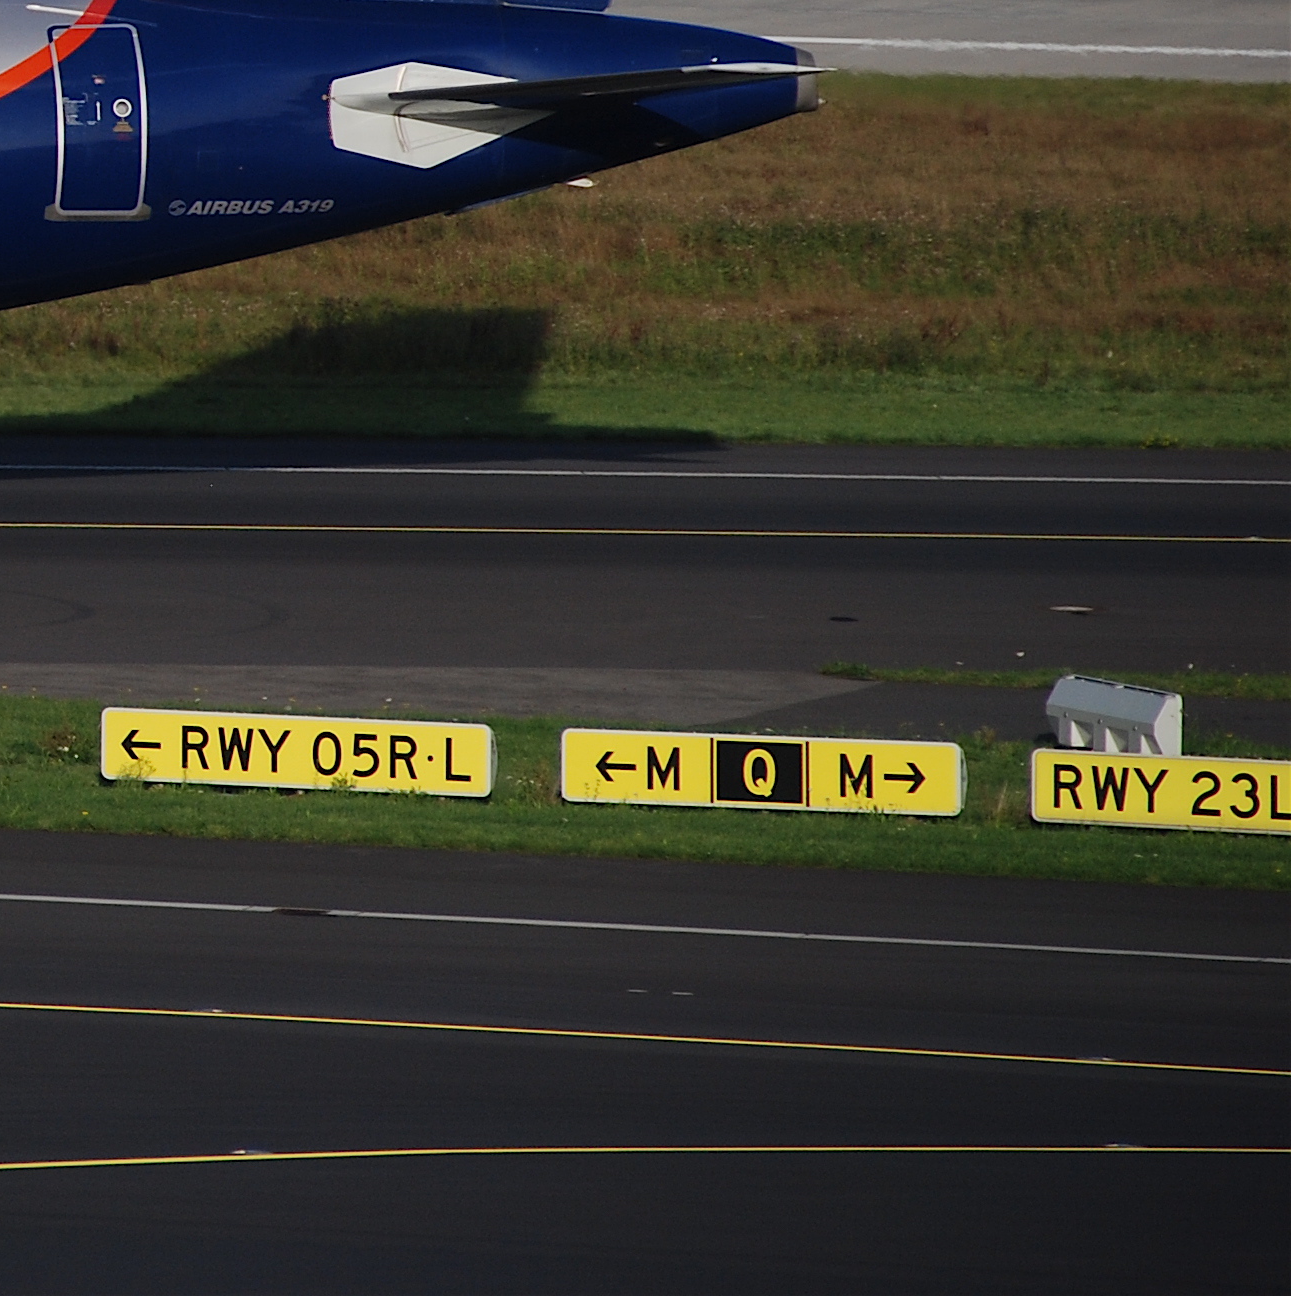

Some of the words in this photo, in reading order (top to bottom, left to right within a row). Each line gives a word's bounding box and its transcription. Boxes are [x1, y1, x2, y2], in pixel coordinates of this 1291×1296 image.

[187, 200, 275, 215] AIRBUS
[278, 199, 335, 214] A319
[181, 725, 291, 773] RWY
[647, 746, 681, 791] M
[742, 747, 777, 798] Q
[839, 753, 873, 798] M
[1053, 764, 1169, 813] RWY
[1191, 770, 1291, 821] 23L
